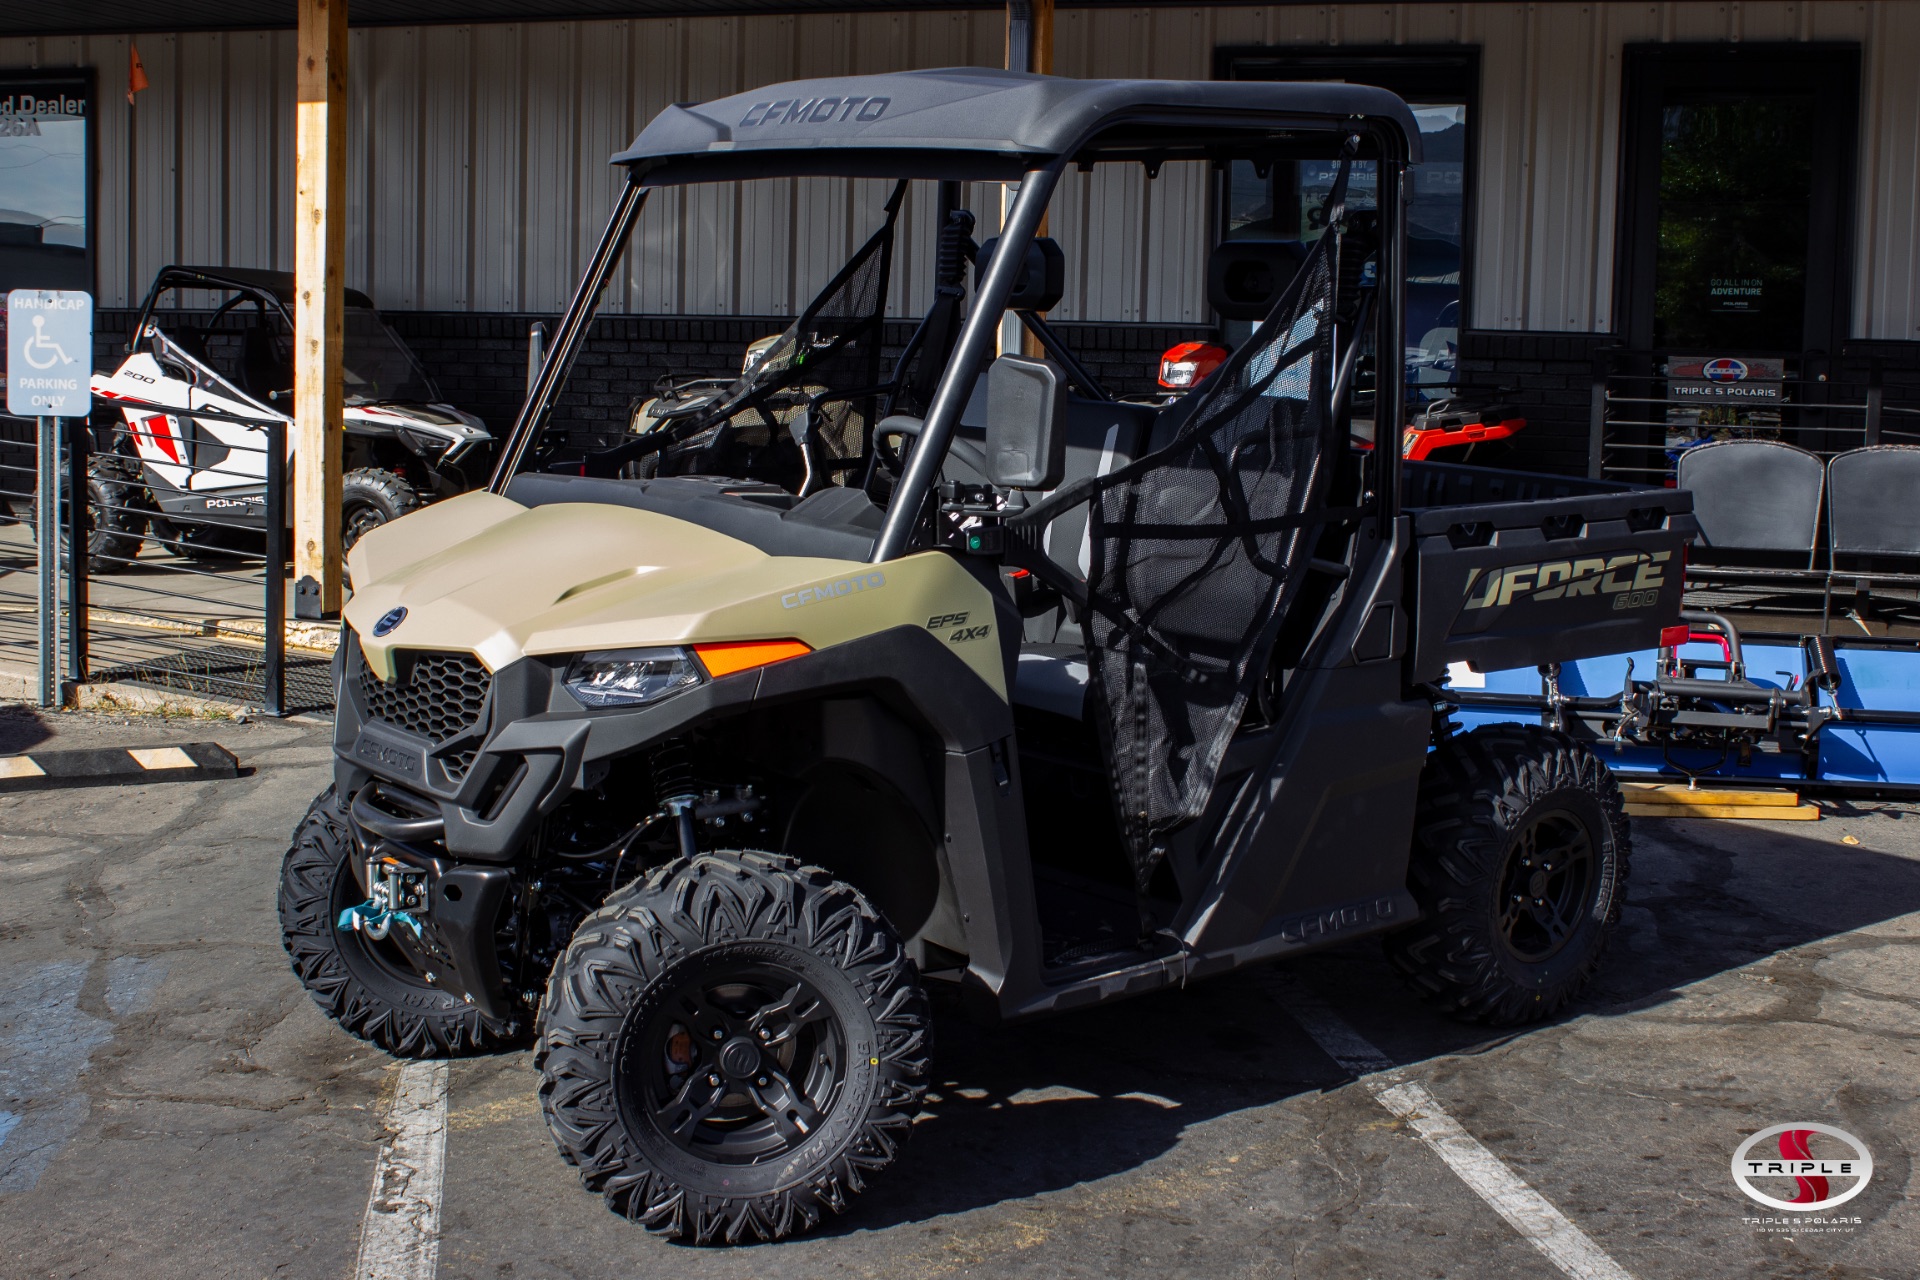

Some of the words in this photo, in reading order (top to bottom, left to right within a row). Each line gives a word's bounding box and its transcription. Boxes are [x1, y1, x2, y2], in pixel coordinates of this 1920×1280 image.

[20, 94, 86, 115] Dealer
[739, 96, 891, 127] CFMOTO
[1710, 279, 1722, 287] GO
[1723, 279, 1738, 287] ALL
[1741, 279, 1749, 287] IN
[1750, 279, 1763, 287] ON
[1710, 288, 1762, 296] ADVENTURE
[14, 298, 85, 310] HANDICAP
[20, 378, 78, 390] PARKING
[1674, 387, 1712, 395] TRIPLE
[1715, 387, 1723, 396] S
[1727, 388, 1776, 397] POLARIS
[31, 395, 66, 407] ONLY
[1463, 551, 1672, 610] UFORCE
[780, 571, 886, 610] CFMOTO
[1613, 589, 1659, 611] 600
[926, 612, 969, 629] EPS
[949, 625, 989, 643] 4X4
[361, 738, 417, 772] CFMOTO
[1281, 898, 1392, 943] CFMOTO
[836, 1039, 871, 1129] BRUISER
